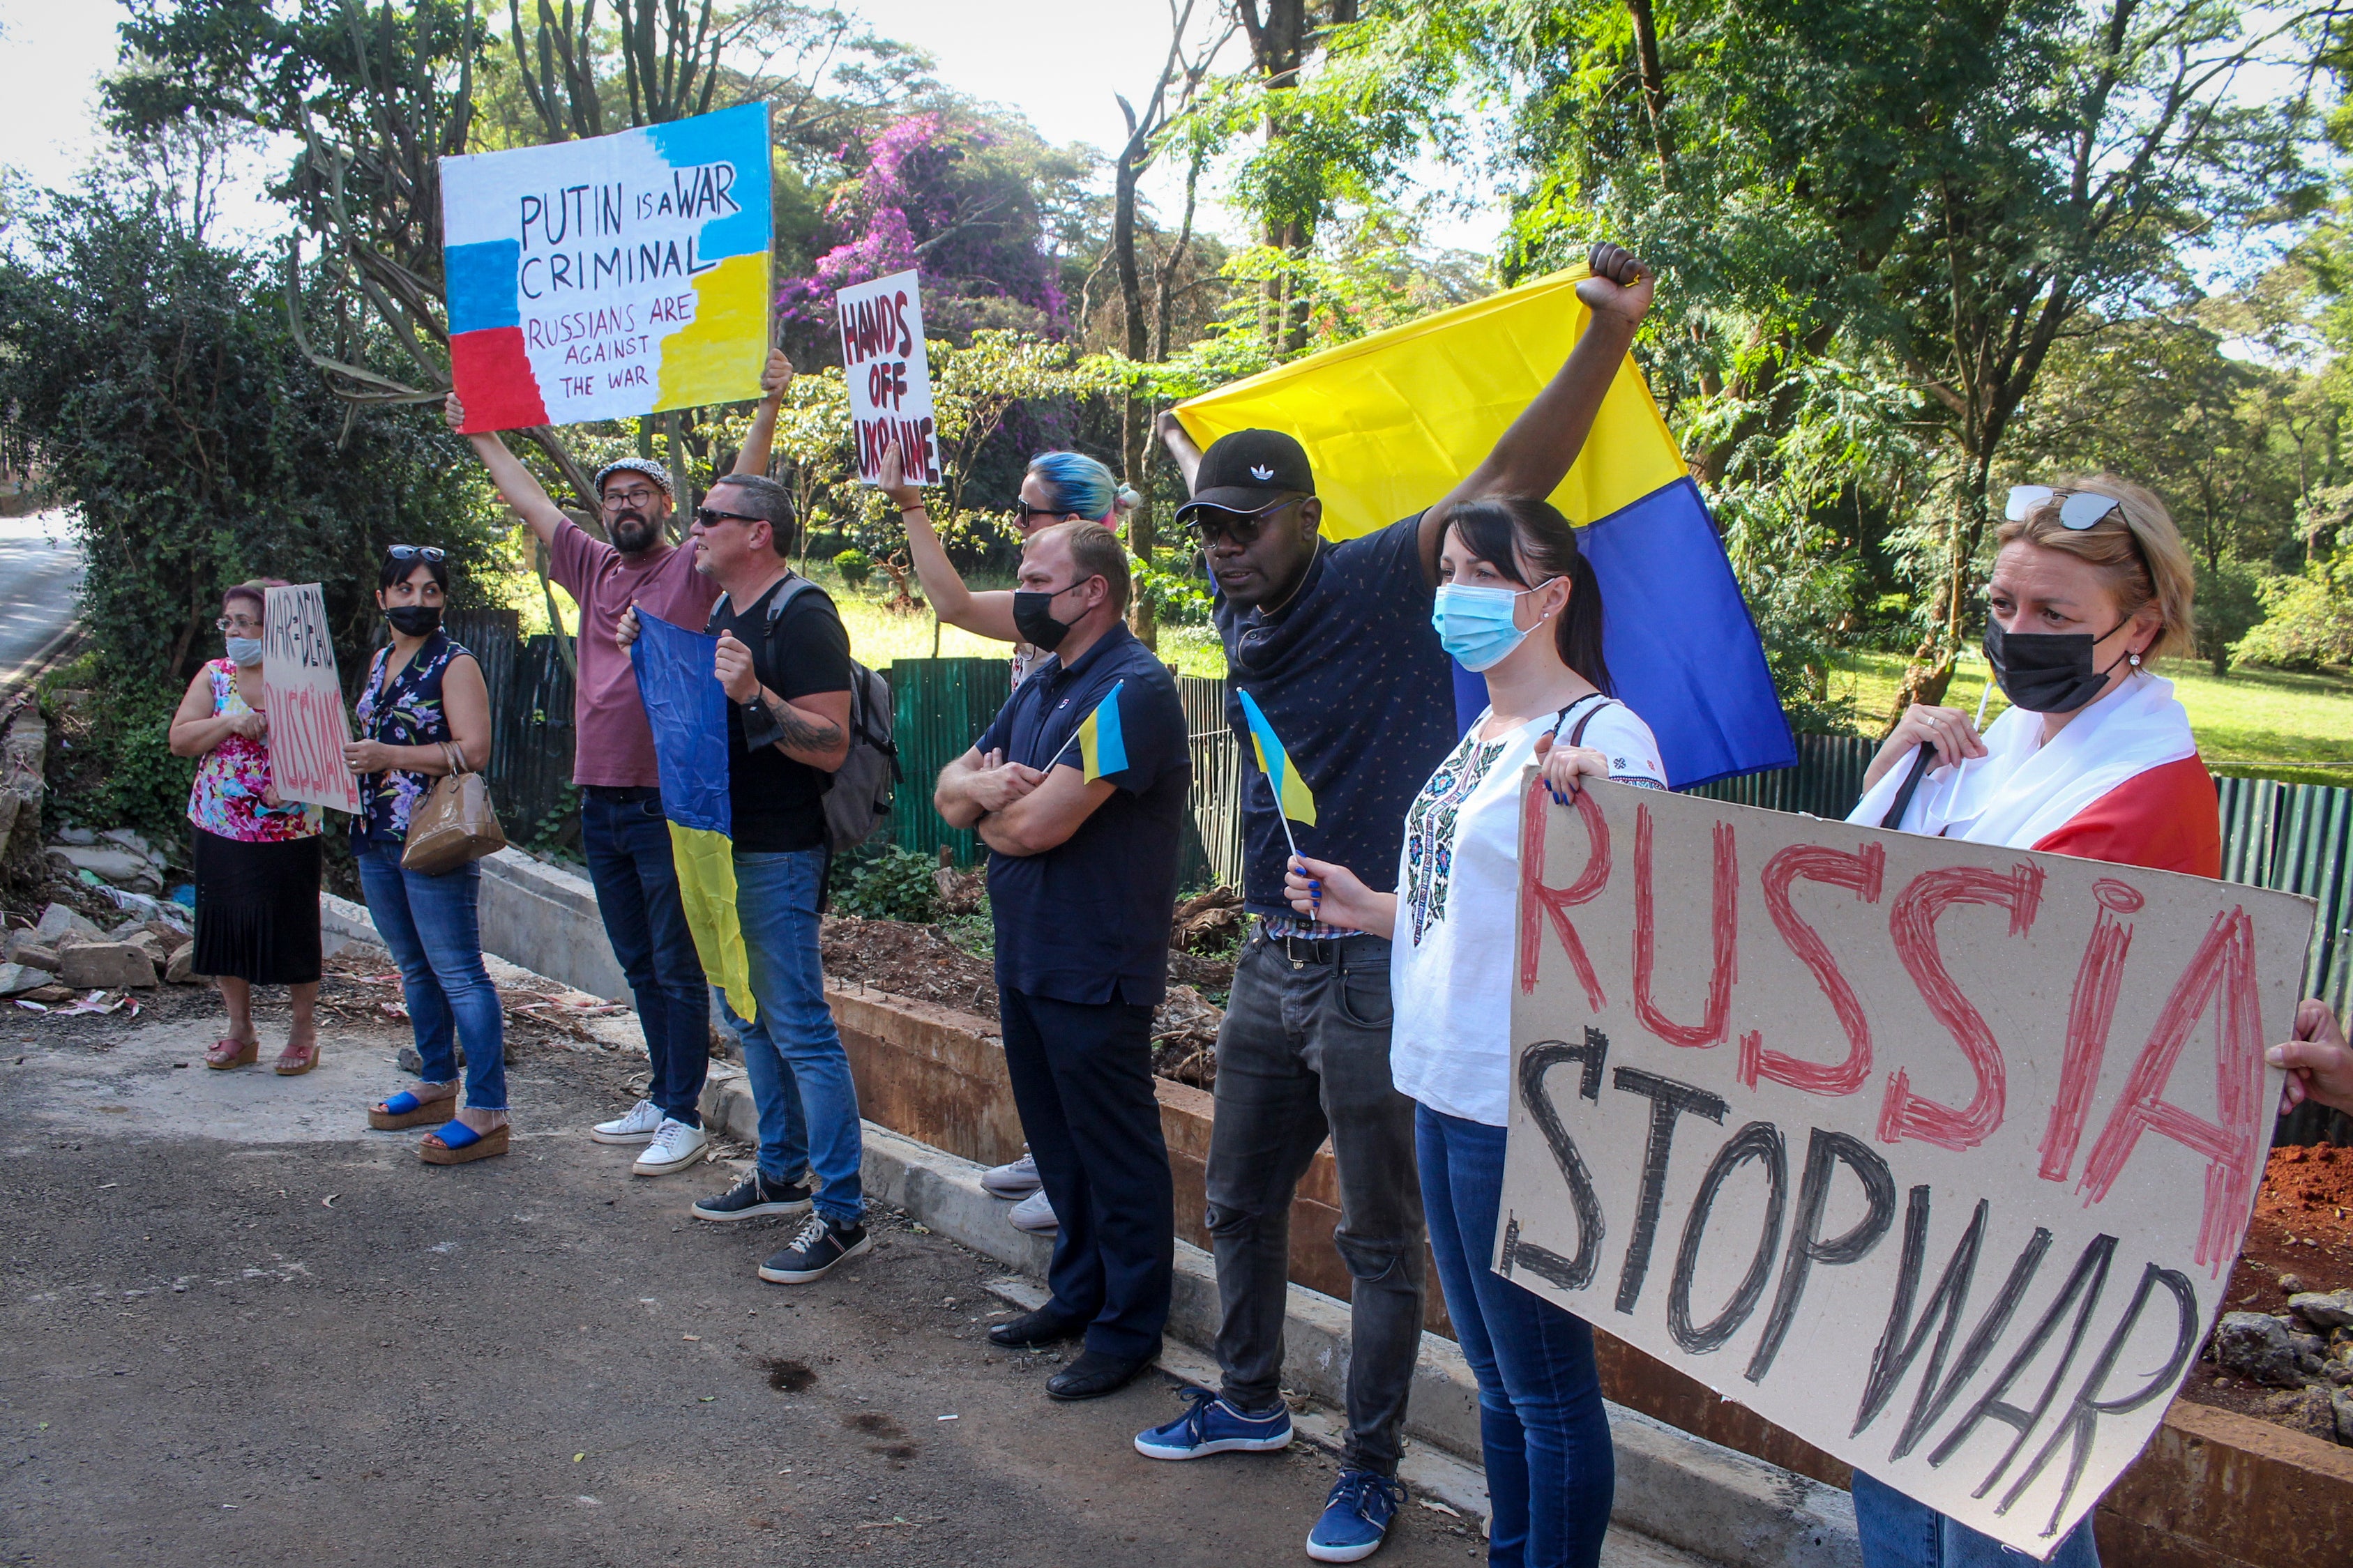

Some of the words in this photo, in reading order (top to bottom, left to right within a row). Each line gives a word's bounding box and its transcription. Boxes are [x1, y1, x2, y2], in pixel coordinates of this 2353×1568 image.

[520, 183, 622, 251] PUTIN
[637, 193, 653, 220] IS
[658, 192, 672, 215] A
[674, 165, 739, 219] WAR
[521, 236, 717, 299] CRIMINAL
[529, 304, 635, 350] RUSSIANS
[649, 293, 693, 325] ARE
[564, 335, 649, 365] AGAINST
[841, 290, 912, 366] HANDS
[559, 375, 594, 399] THE
[608, 365, 649, 390] WAR
[868, 361, 907, 412] OFF
[1499, 1025, 1896, 1385] STOP
[1849, 1185, 2199, 1537] WAR
